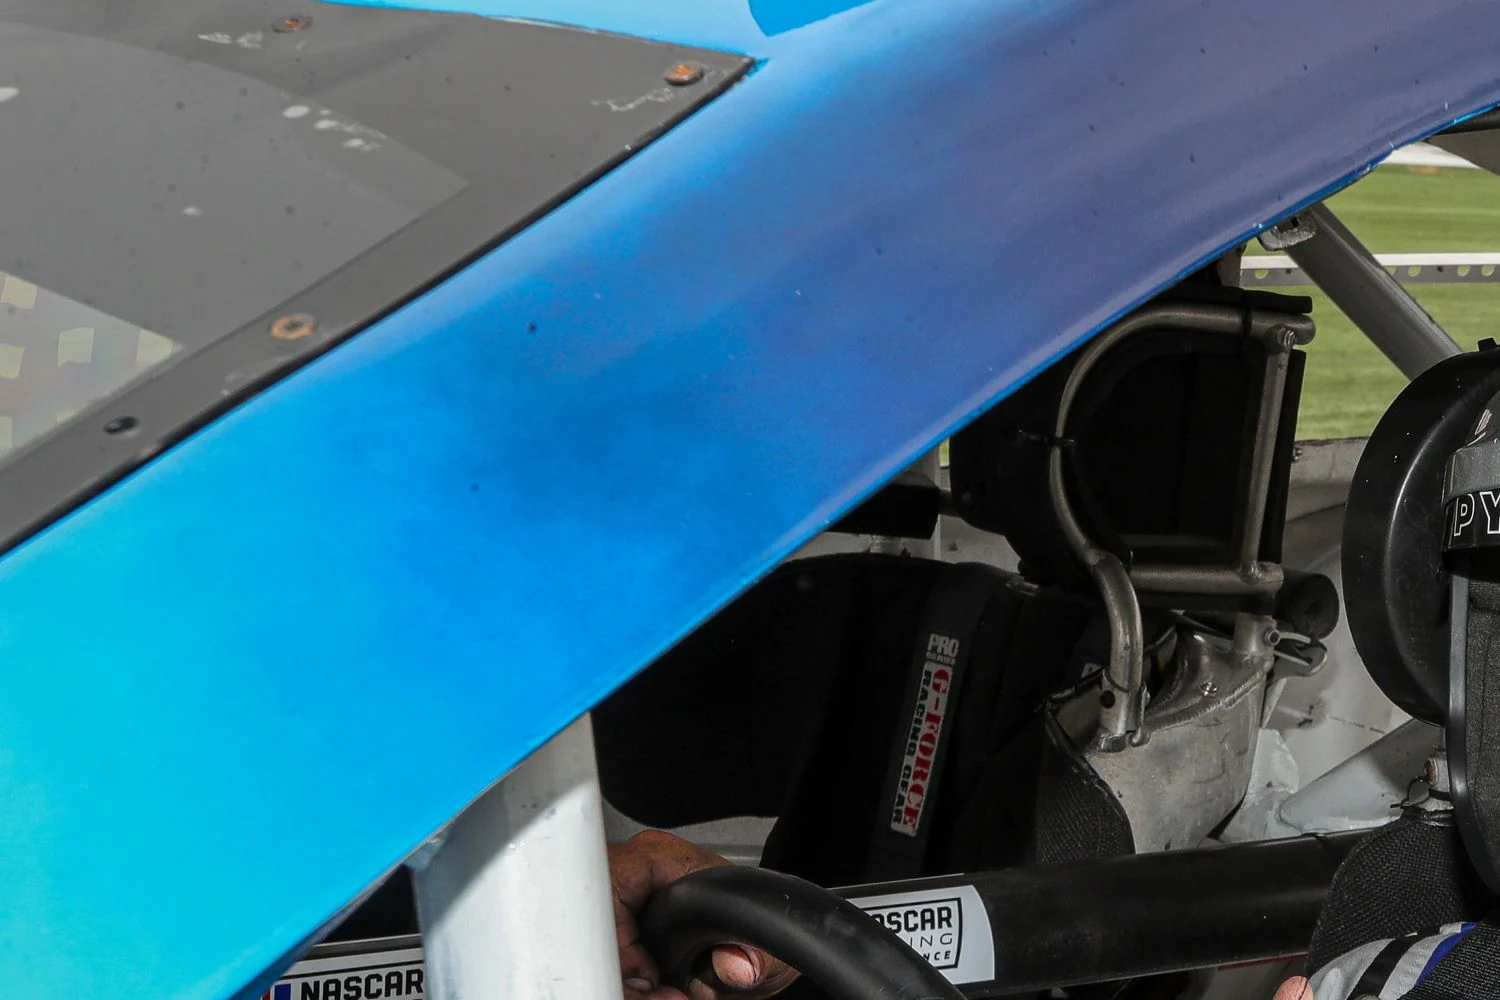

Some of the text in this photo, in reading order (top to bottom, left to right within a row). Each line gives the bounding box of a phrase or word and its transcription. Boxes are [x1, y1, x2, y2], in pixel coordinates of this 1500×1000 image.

[927, 633, 960, 658] PRO
[893, 669, 932, 824] RACING GEAR
[903, 669, 950, 828] G-FORCE
